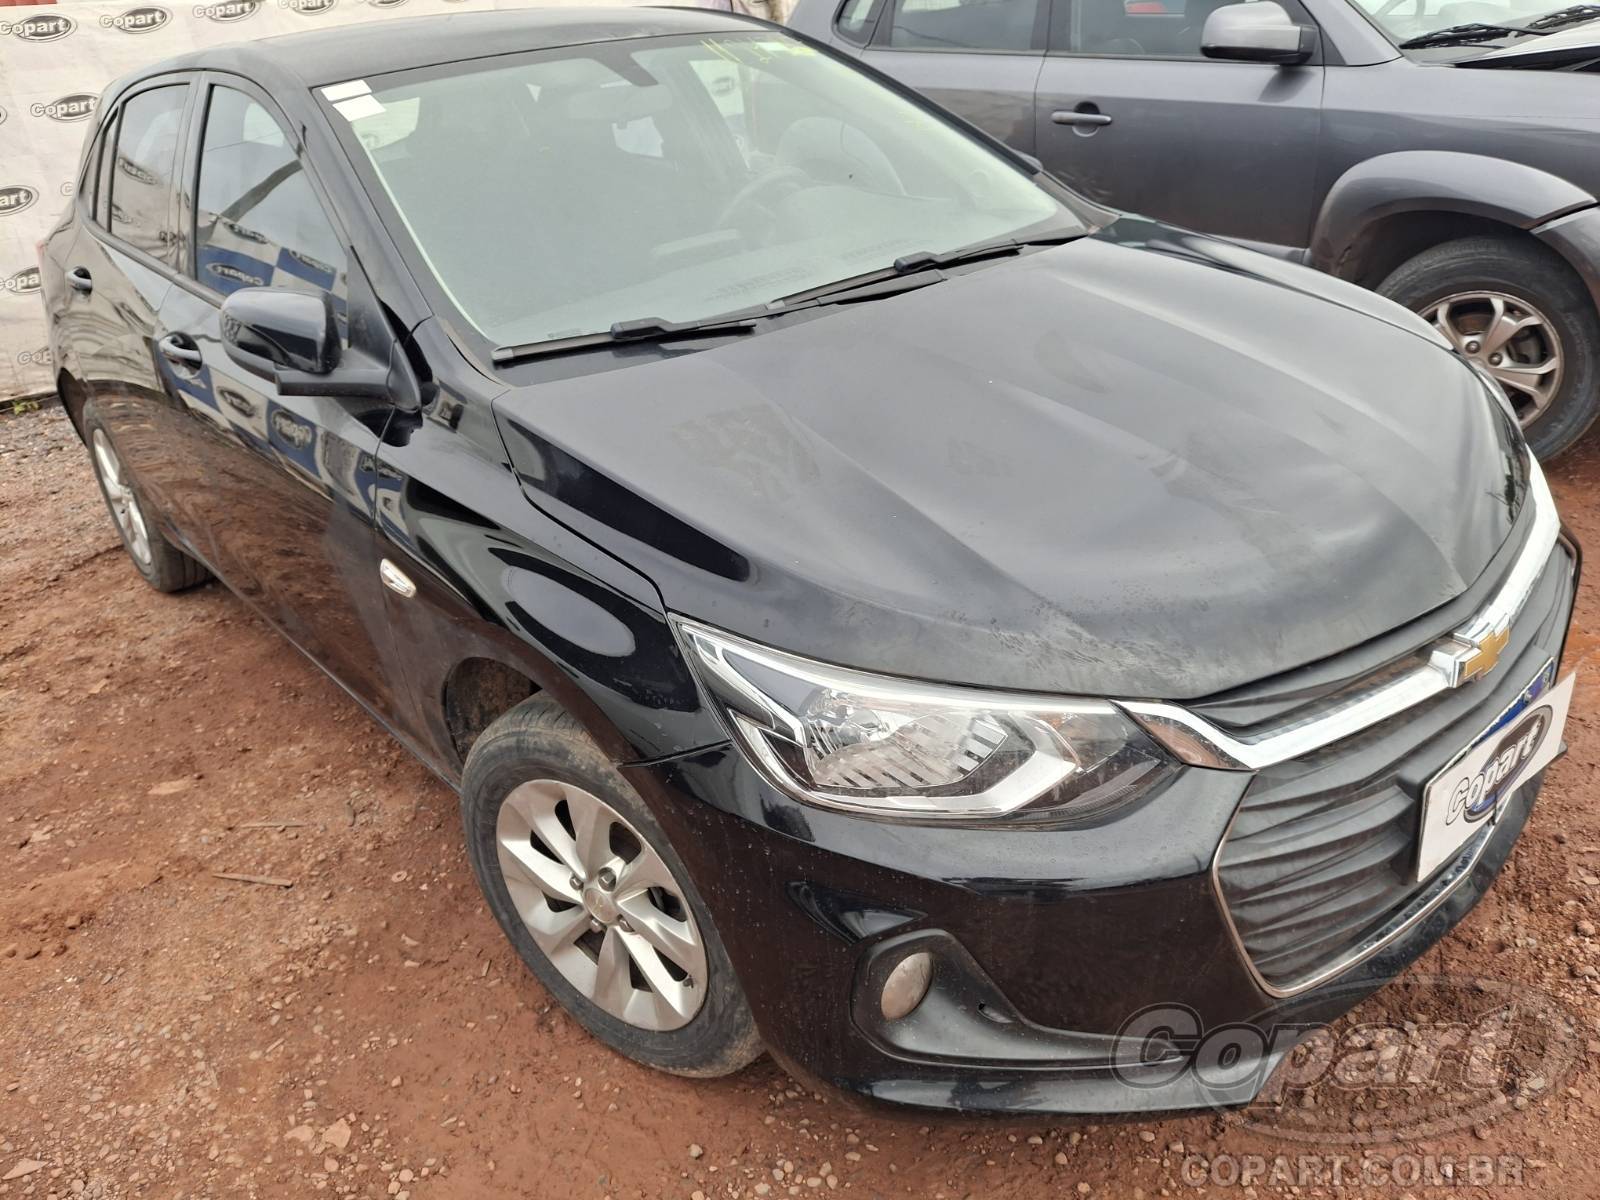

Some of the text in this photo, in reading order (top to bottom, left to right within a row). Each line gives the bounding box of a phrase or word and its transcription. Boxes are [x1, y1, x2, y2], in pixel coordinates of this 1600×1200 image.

[100, 10, 165, 28] Copart
[193, 0, 255, 19] Copart
[0, 18, 67, 37] Copart
[30, 98, 96, 118] Copart
[1445, 713, 1545, 826] Copart
